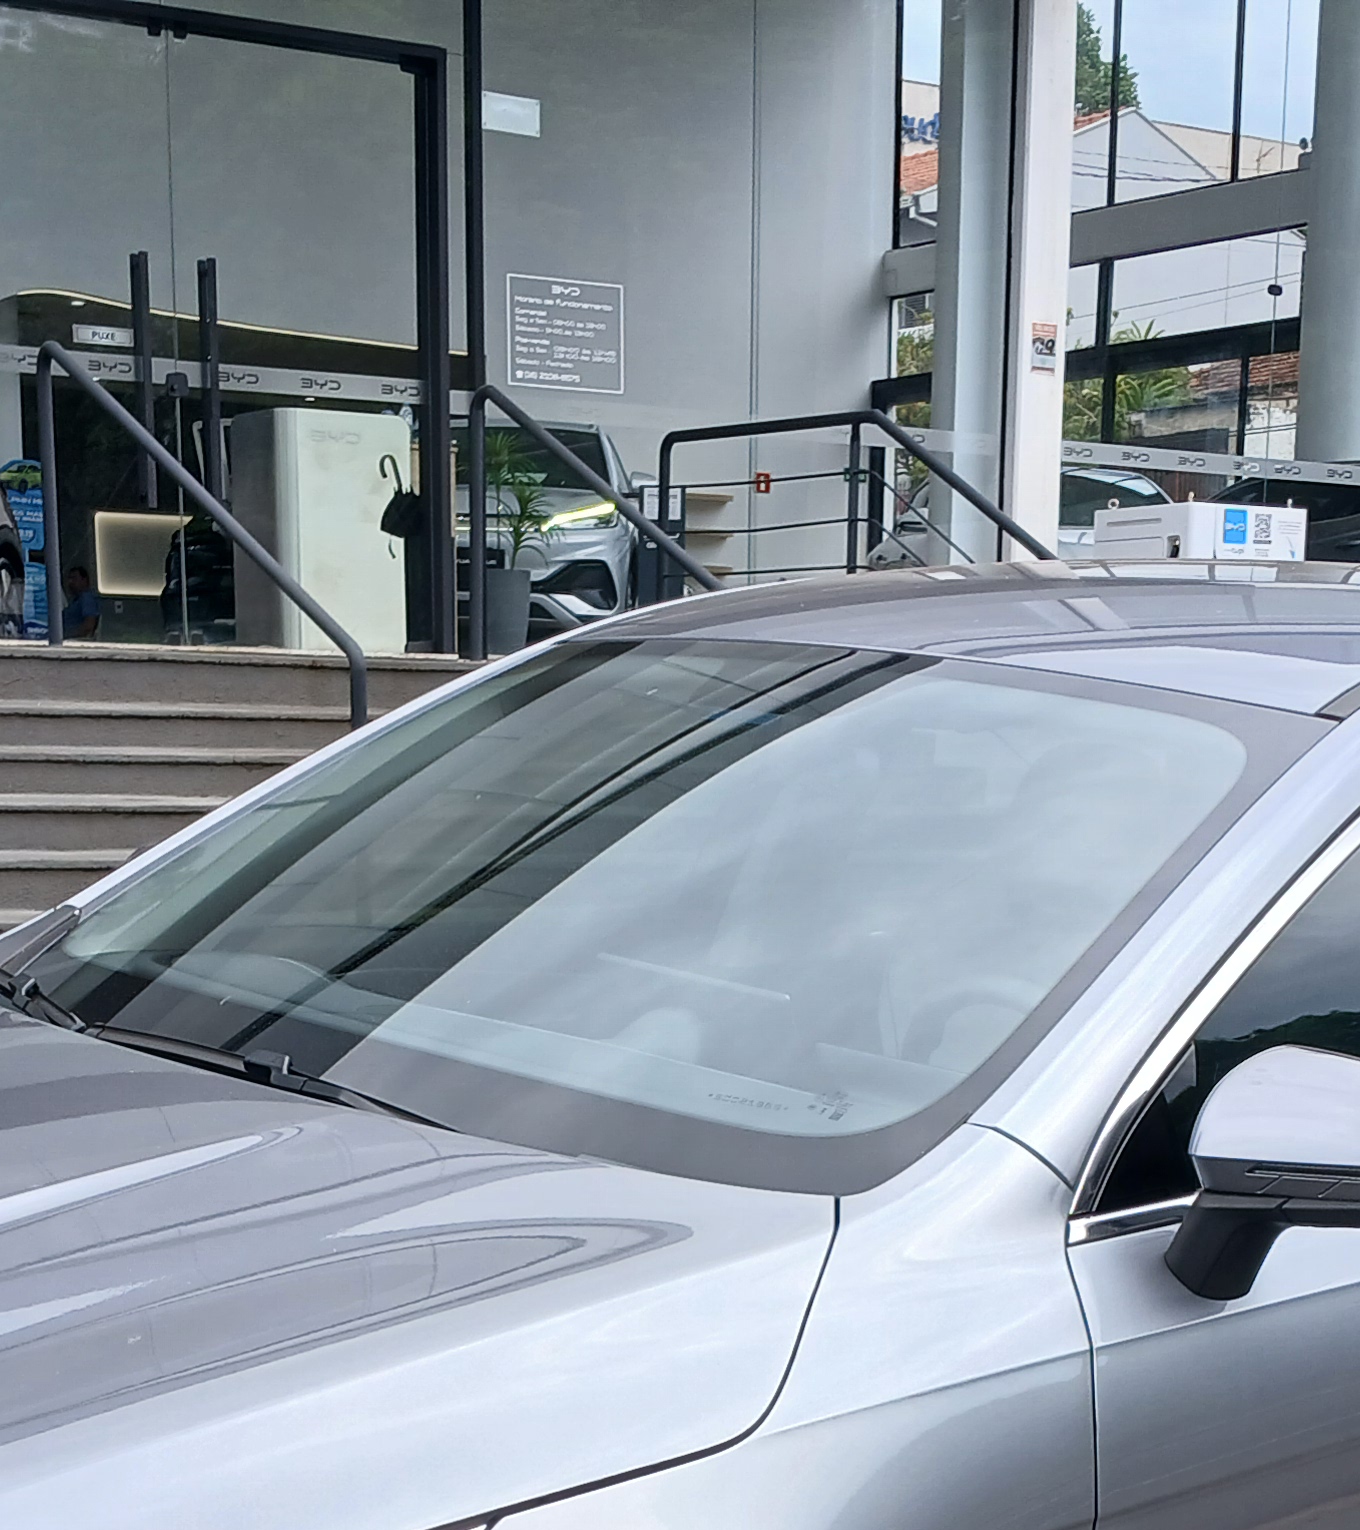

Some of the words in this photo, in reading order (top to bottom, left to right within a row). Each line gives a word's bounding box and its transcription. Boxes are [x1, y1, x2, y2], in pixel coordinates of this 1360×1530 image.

[88, 359, 132, 373] BYD
[300, 377, 341, 391] BYD
[380, 383, 421, 397] BYD
[1121, 451, 1150, 463] BYD
[1326, 468, 1352, 480] BYD
